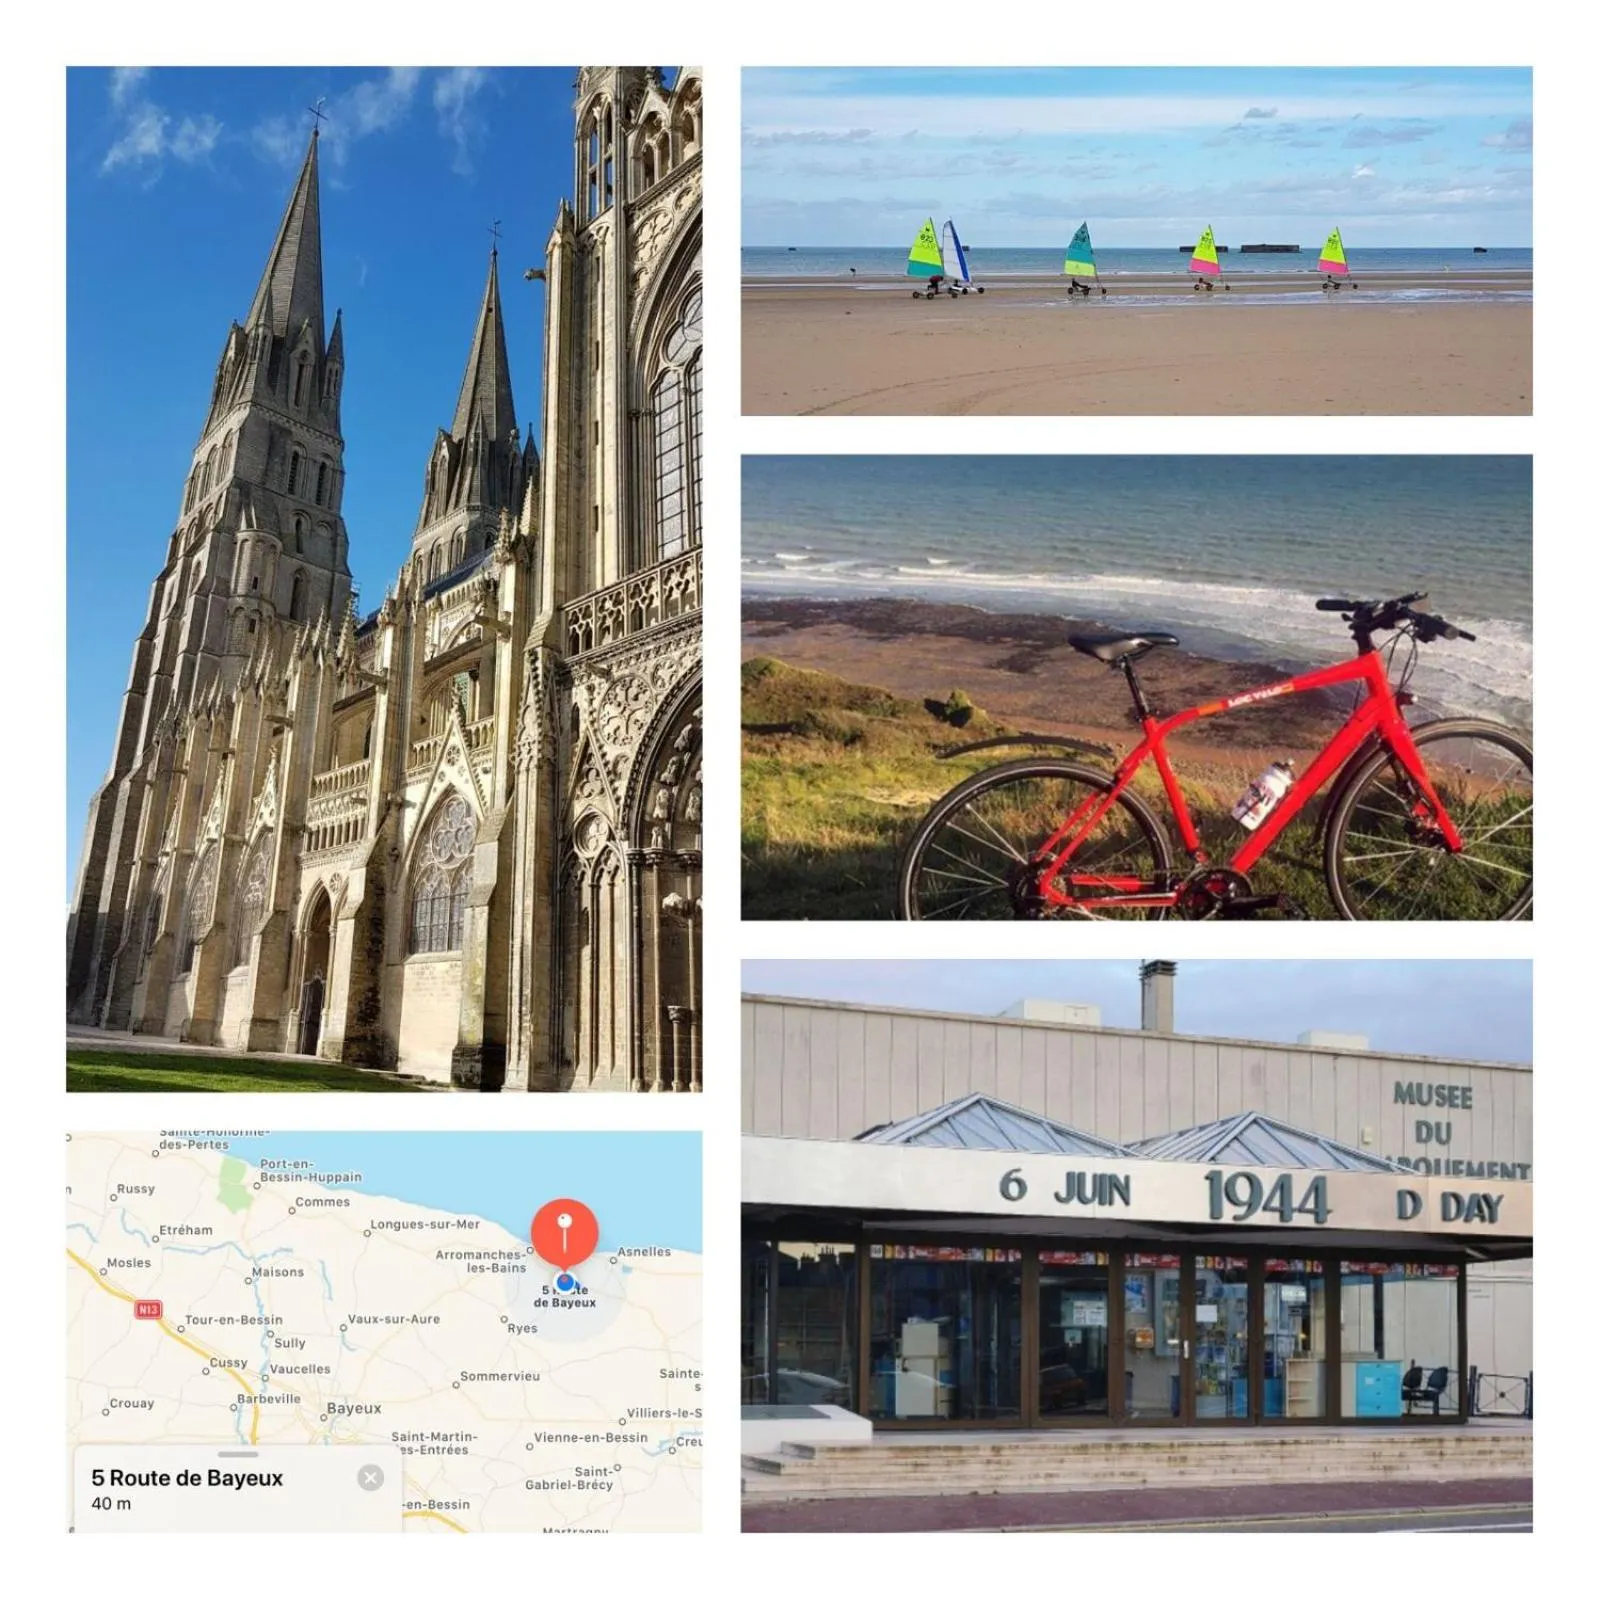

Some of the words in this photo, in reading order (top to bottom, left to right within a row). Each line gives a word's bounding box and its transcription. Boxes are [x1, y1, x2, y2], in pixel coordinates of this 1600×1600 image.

[1394, 1081, 1473, 1110] MUSEE
[1415, 1120, 1452, 1145] DU
[159, 1139, 229, 1150] des-Pertes
[260, 1159, 314, 1169] Port-en-
[260, 1171, 362, 1183] Bessin-Huppain
[117, 1183, 155, 1196] Russy
[295, 1196, 351, 1208] Commes
[999, 1168, 1028, 1202] 6
[1054, 1171, 1131, 1206] JUIN
[1204, 1169, 1333, 1224] 1944
[1397, 1189, 1423, 1221] D
[1441, 1191, 1504, 1224] DAY
[159, 1224, 213, 1235] Etréham
[370, 1219, 480, 1232] Longues-sur-Mer
[436, 1249, 527, 1260] Arromanches-
[617, 1246, 672, 1257] Asnelles
[107, 1257, 152, 1268] Mosles
[466, 1262, 527, 1273] les-Bains
[252, 1266, 305, 1278] Maisons
[542, 1285, 550, 1295] 5
[139, 1303, 159, 1315] N13
[534, 1297, 549, 1308] de
[552, 1297, 596, 1310] Bayeux
[185, 1314, 284, 1325] Tour-en-Bessin
[348, 1313, 441, 1325] Vaux-sur-Aure
[508, 1323, 538, 1336] Ryes
[274, 1338, 306, 1351] Sully
[210, 1357, 248, 1370] Cussy
[270, 1363, 331, 1375] Vaucelles
[460, 1371, 541, 1382] Sommervieu
[110, 1398, 155, 1411] Crouay
[237, 1393, 301, 1405] Barbeville
[327, 1402, 382, 1417] Bayeux
[627, 1408, 703, 1419] Villiers-le-S
[392, 1431, 478, 1442] Saint-Martin-
[534, 1431, 649, 1443] Vienne-en-Bessin
[400, 1443, 469, 1456] es-Entrées
[575, 1466, 613, 1477] Saint-
[91, 1468, 106, 1487] 5
[110, 1469, 171, 1487] Route
[175, 1469, 202, 1487] de
[207, 1469, 284, 1490] Bayeux
[525, 1479, 614, 1492] Gabriel-Brécy
[91, 1497, 112, 1511] 40
[116, 1500, 132, 1511] m
